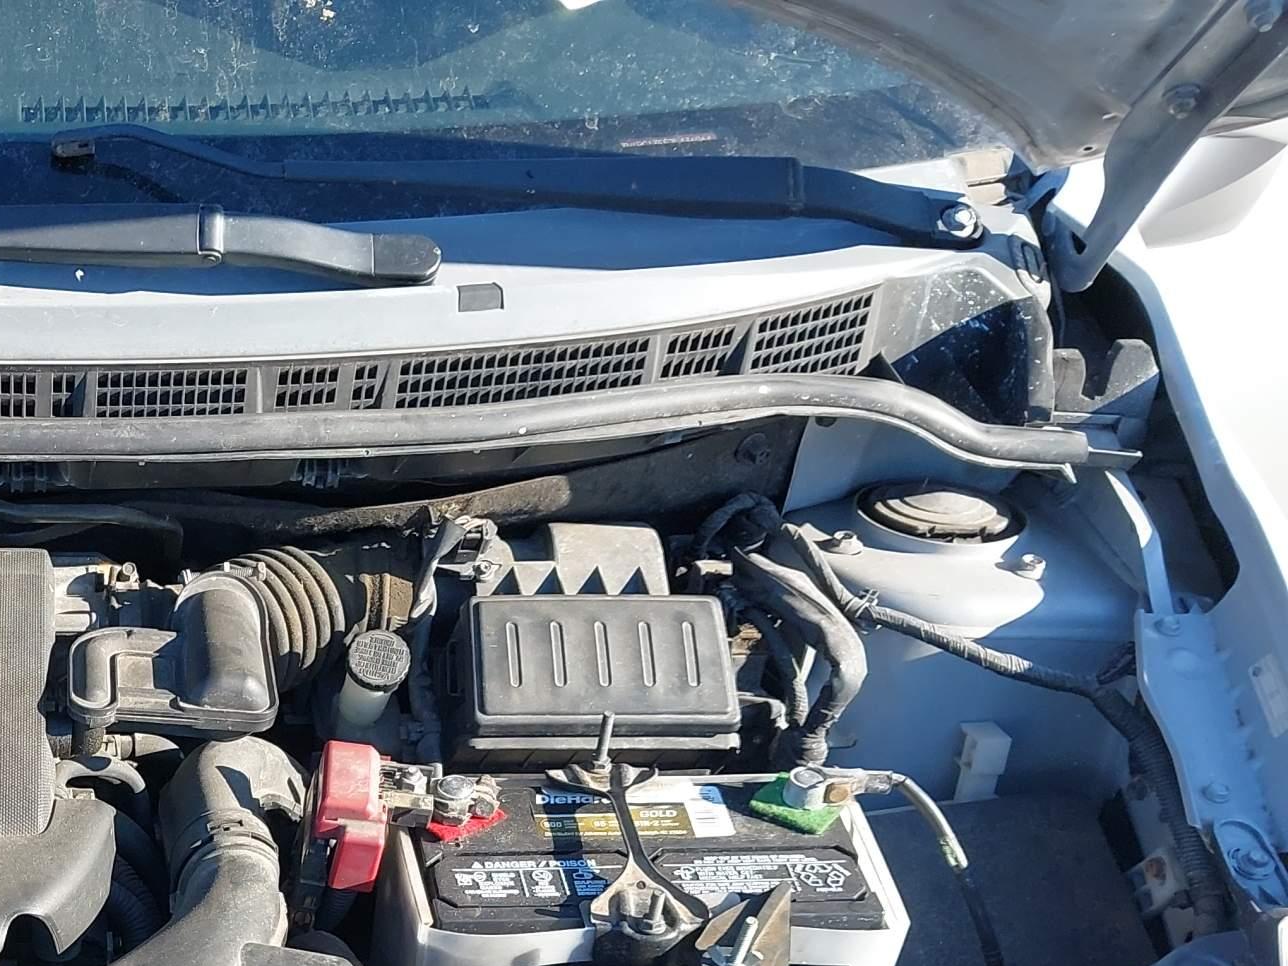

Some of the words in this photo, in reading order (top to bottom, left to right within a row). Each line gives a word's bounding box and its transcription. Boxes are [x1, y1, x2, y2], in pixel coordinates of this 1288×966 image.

[639, 809, 678, 818] GOLD
[484, 861, 537, 869] DANGER
[549, 859, 597, 868] POISON
